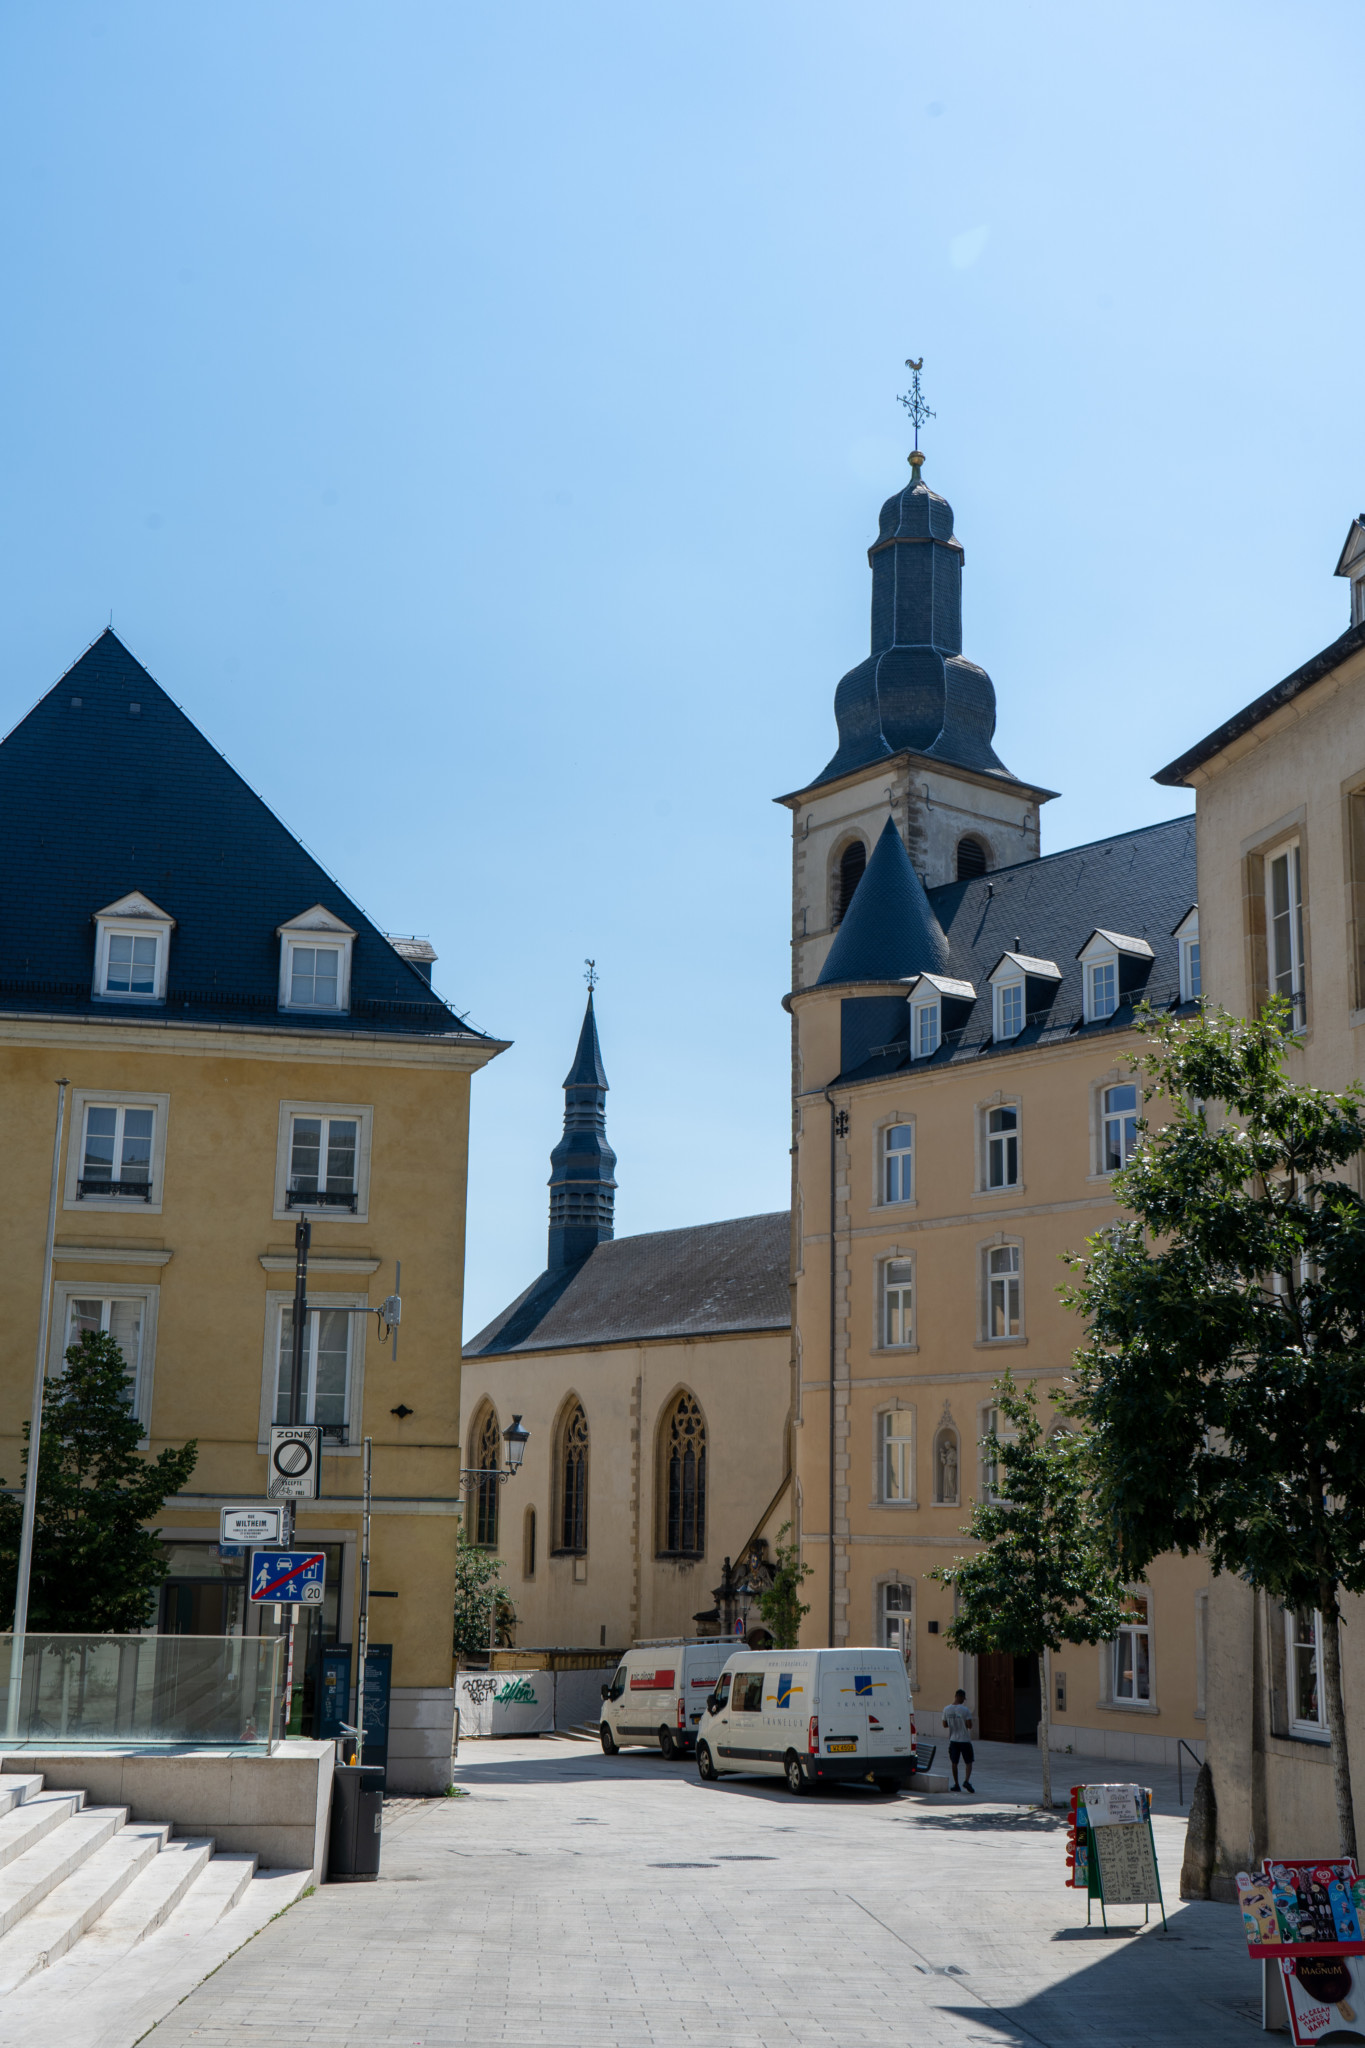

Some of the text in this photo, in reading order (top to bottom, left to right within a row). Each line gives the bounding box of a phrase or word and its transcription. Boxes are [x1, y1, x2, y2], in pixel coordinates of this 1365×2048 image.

[307, 1587, 320, 1599] 20
[1300, 1966, 1342, 1975] MAGNUM
[1297, 2006, 1330, 2022] ICE CREAM
[1303, 2014, 1324, 2027] MAKES
[1307, 2017, 1330, 2033] HAPPY
